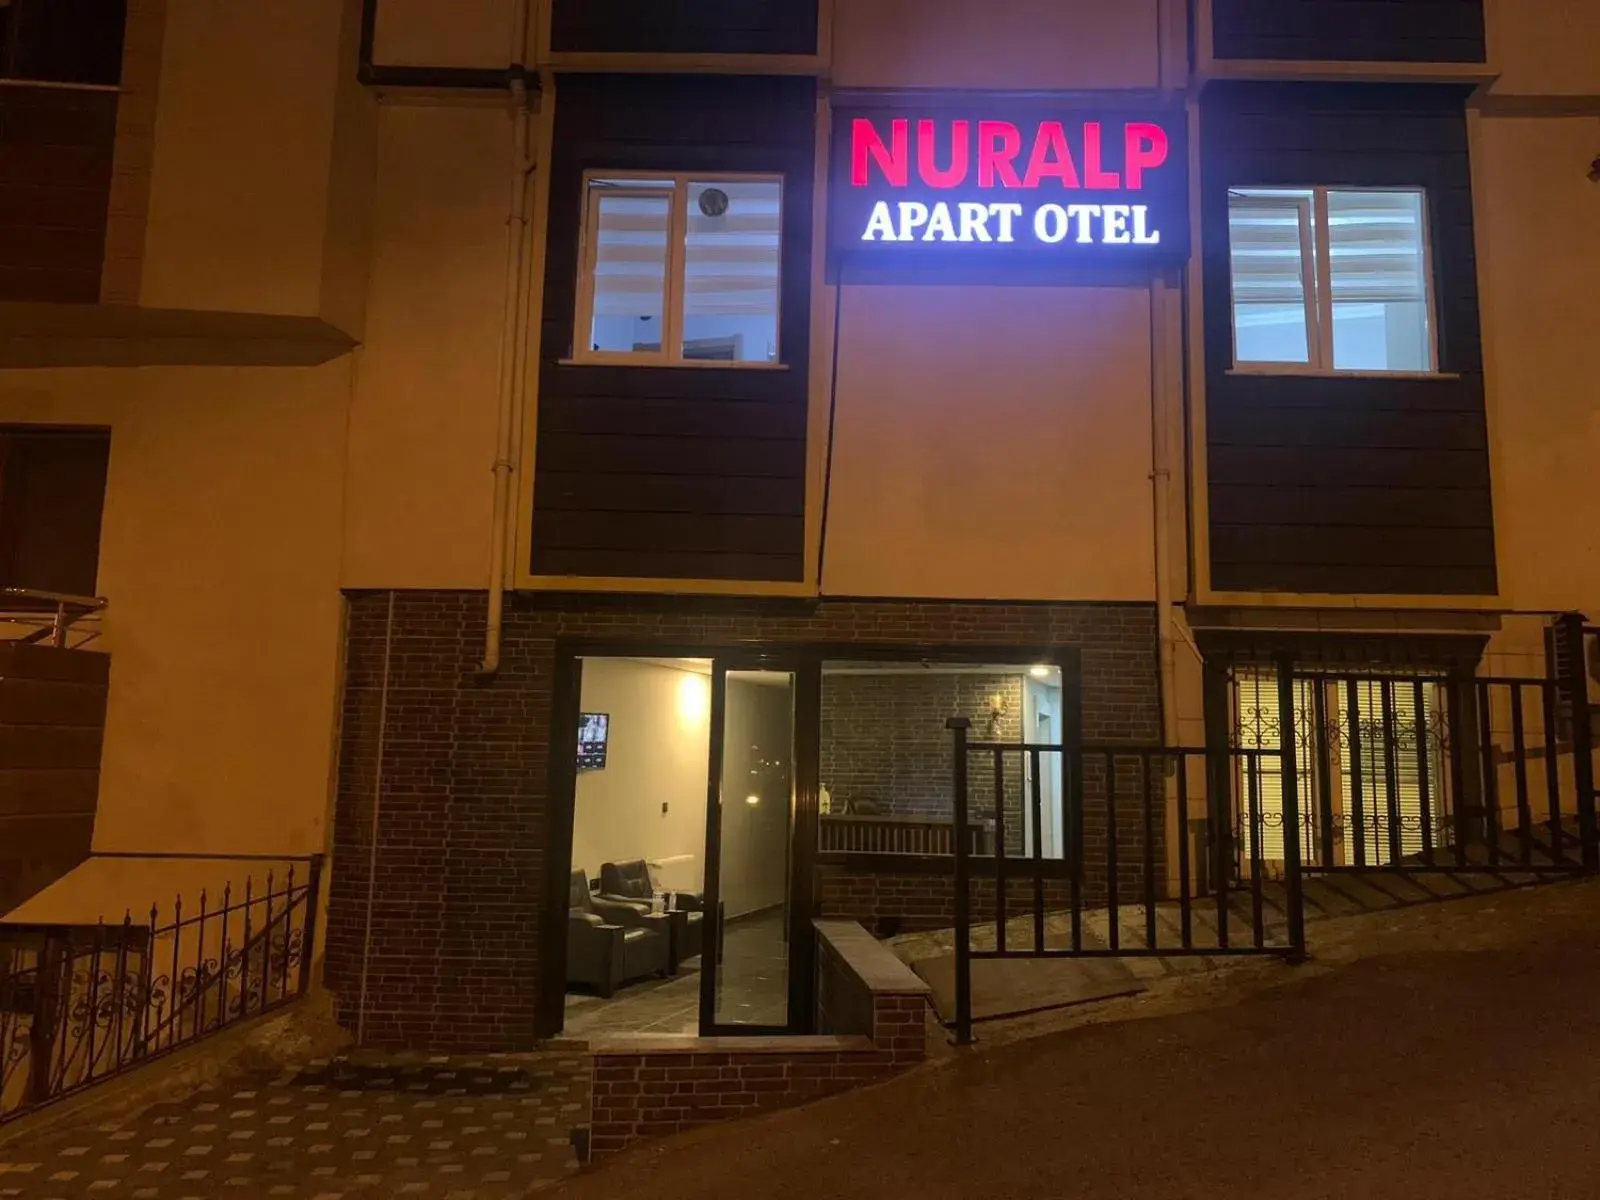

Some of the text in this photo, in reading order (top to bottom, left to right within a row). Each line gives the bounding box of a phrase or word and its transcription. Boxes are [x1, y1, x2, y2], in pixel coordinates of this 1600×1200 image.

[851, 118, 1168, 189] NURALP
[861, 201, 1160, 244] APART OTEL
